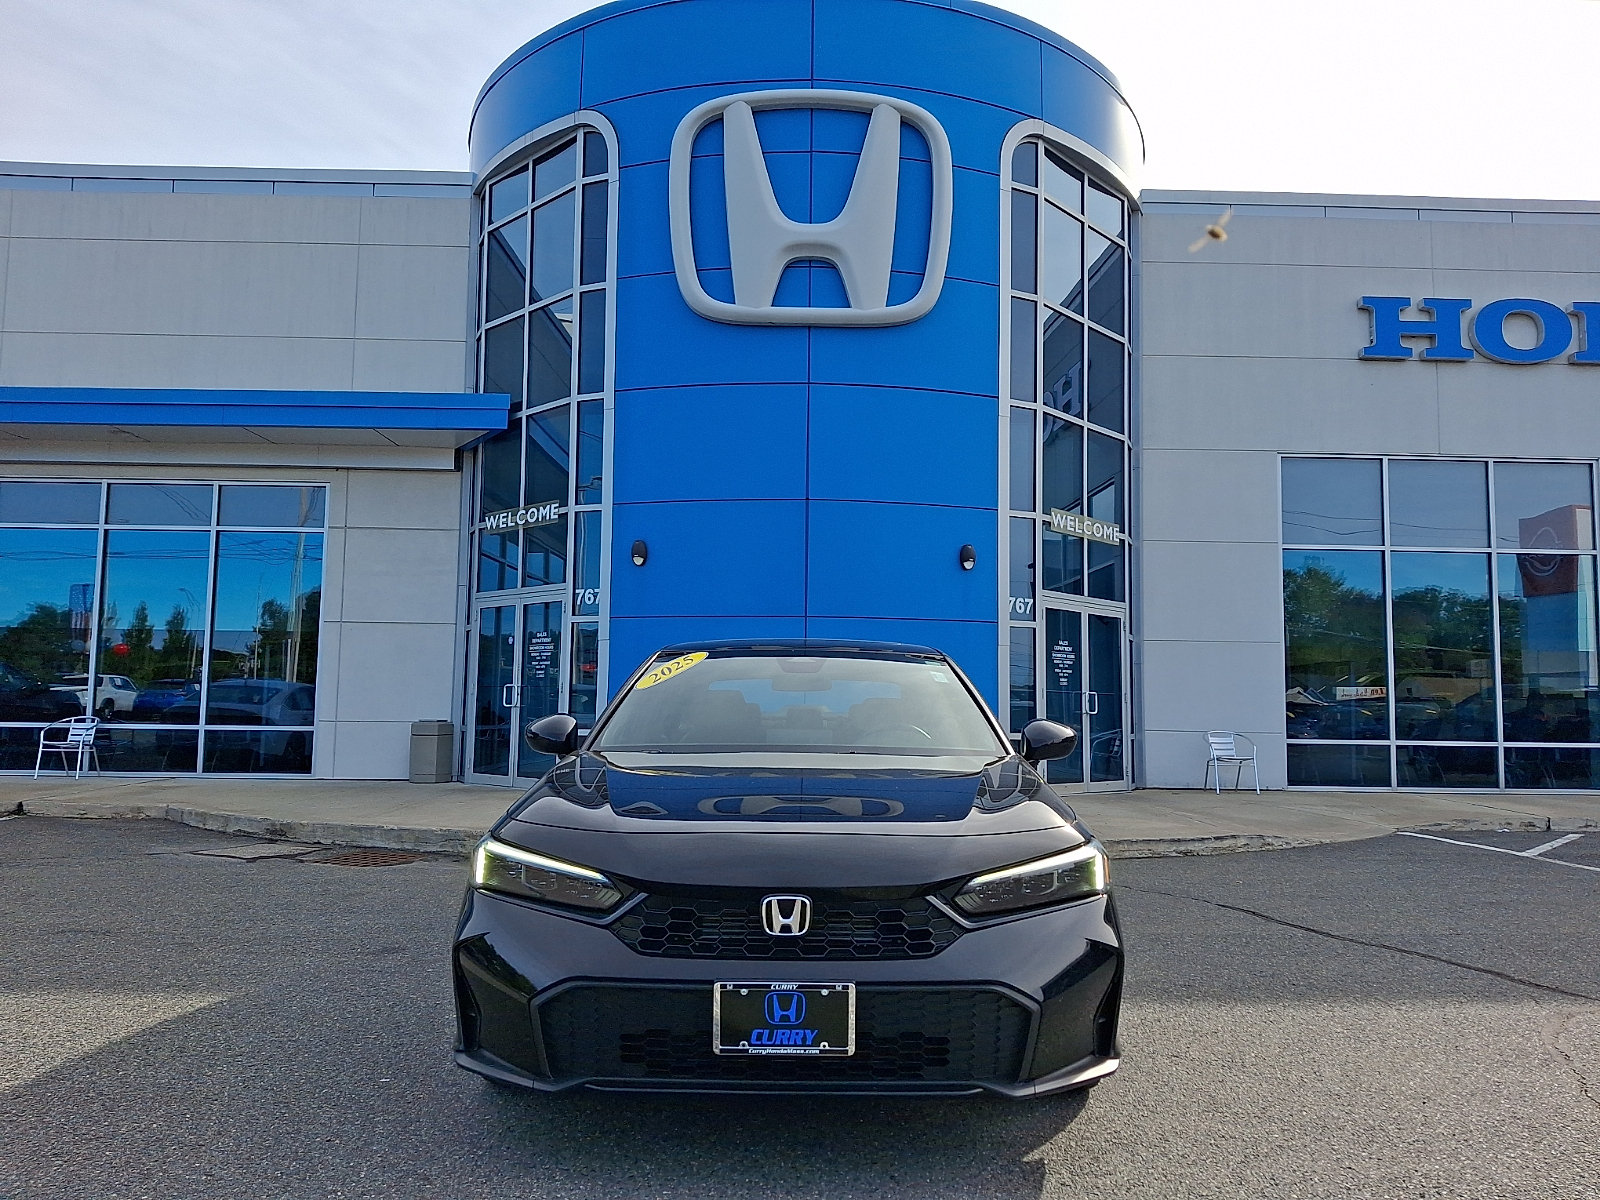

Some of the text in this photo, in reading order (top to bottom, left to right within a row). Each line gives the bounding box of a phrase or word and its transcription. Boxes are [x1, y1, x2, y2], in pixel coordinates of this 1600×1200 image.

[485, 503, 559, 530] WELCOME
[1051, 511, 1120, 542] WELCOME
[648, 656, 694, 684] 2025
[750, 1029, 818, 1045] CURRY
